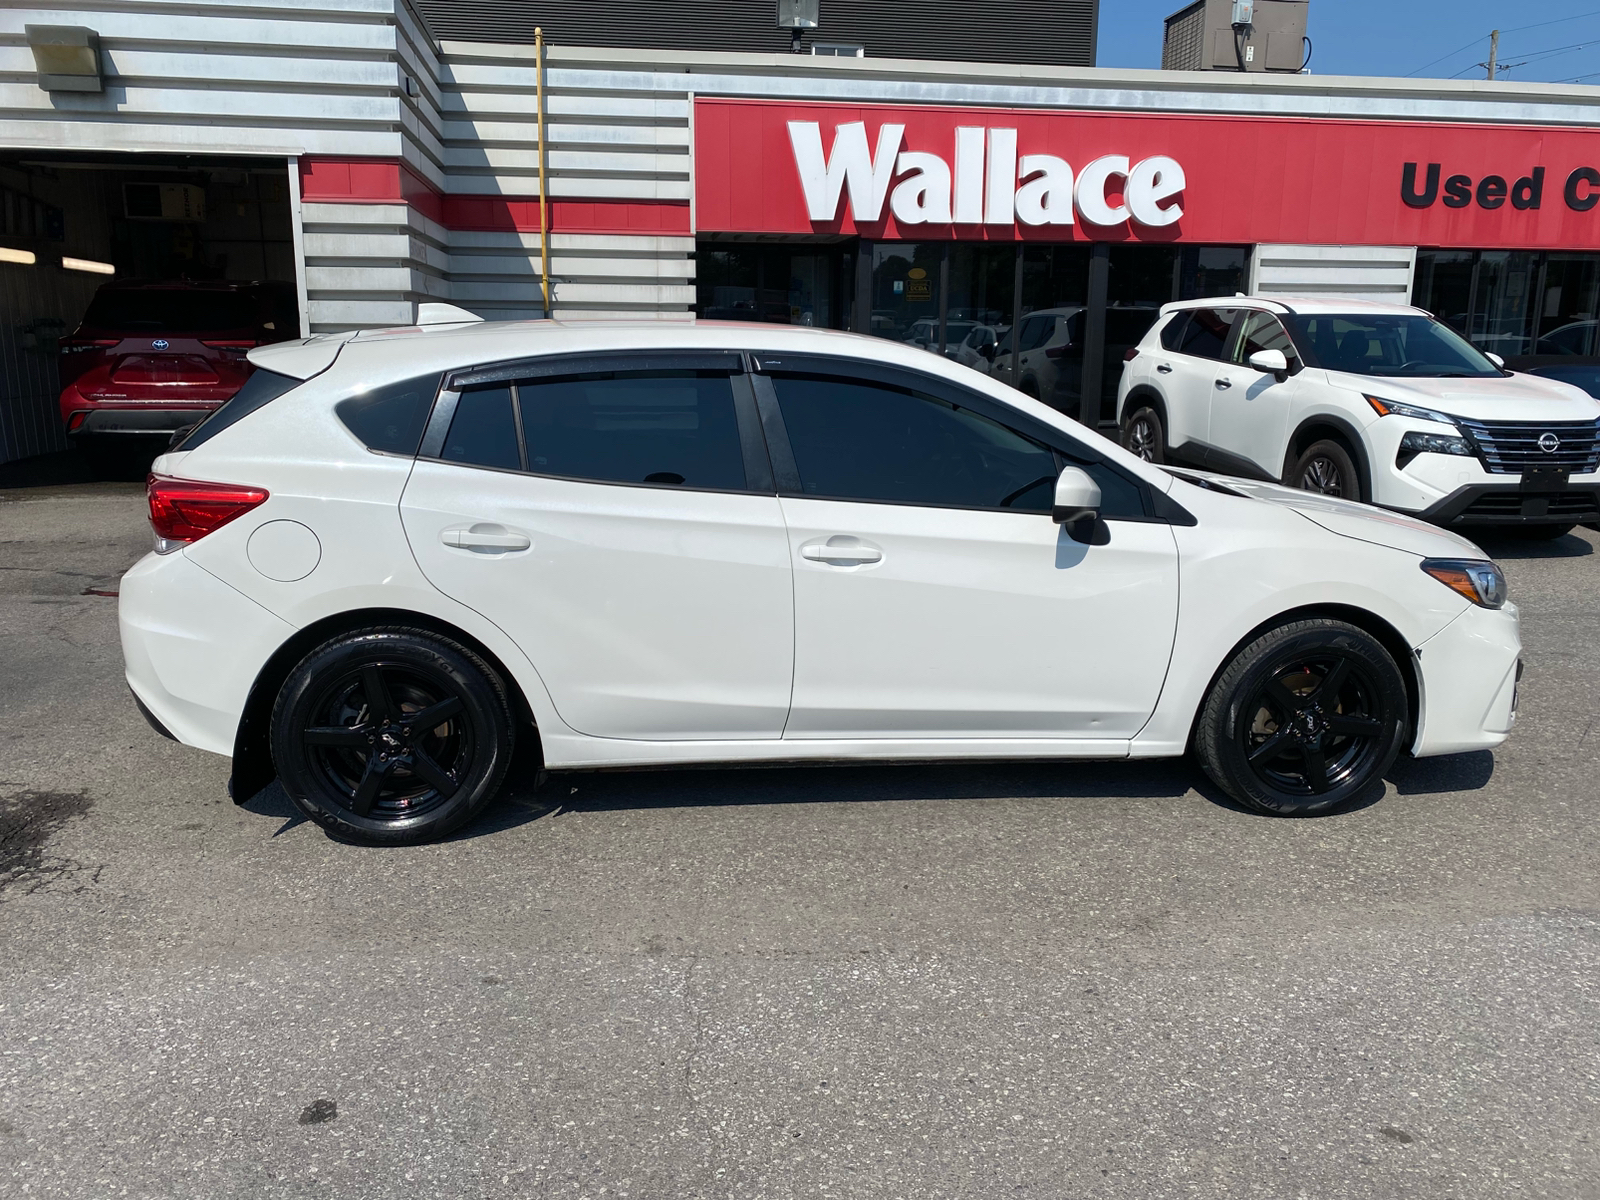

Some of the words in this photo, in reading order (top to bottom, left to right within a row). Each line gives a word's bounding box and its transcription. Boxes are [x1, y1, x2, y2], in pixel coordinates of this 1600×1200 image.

[787, 120, 1186, 227] Wallace
[1401, 162, 1545, 210] Used
[1564, 166, 1600, 212] C
[183, 187, 191, 217] REZNOR
